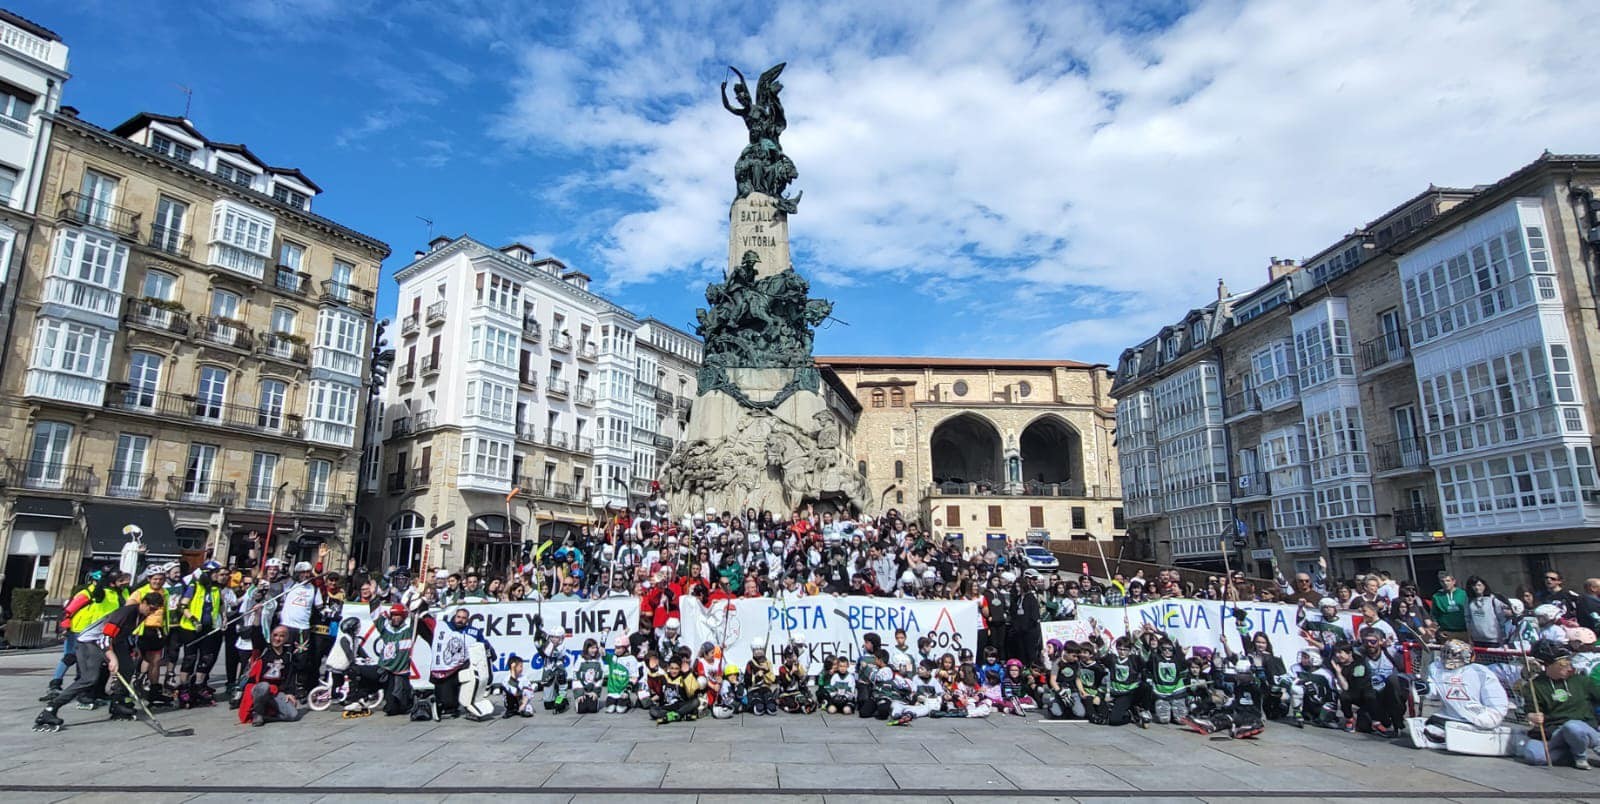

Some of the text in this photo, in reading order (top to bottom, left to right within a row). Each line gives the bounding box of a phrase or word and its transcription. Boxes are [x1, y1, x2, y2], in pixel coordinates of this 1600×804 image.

[741, 211, 776, 222] BATALL
[743, 236, 776, 247] VITORIA
[443, 612, 541, 637] CKEY
[1140, 603, 1289, 634] NUEVA PSTA
[928, 631, 962, 652] SOS
